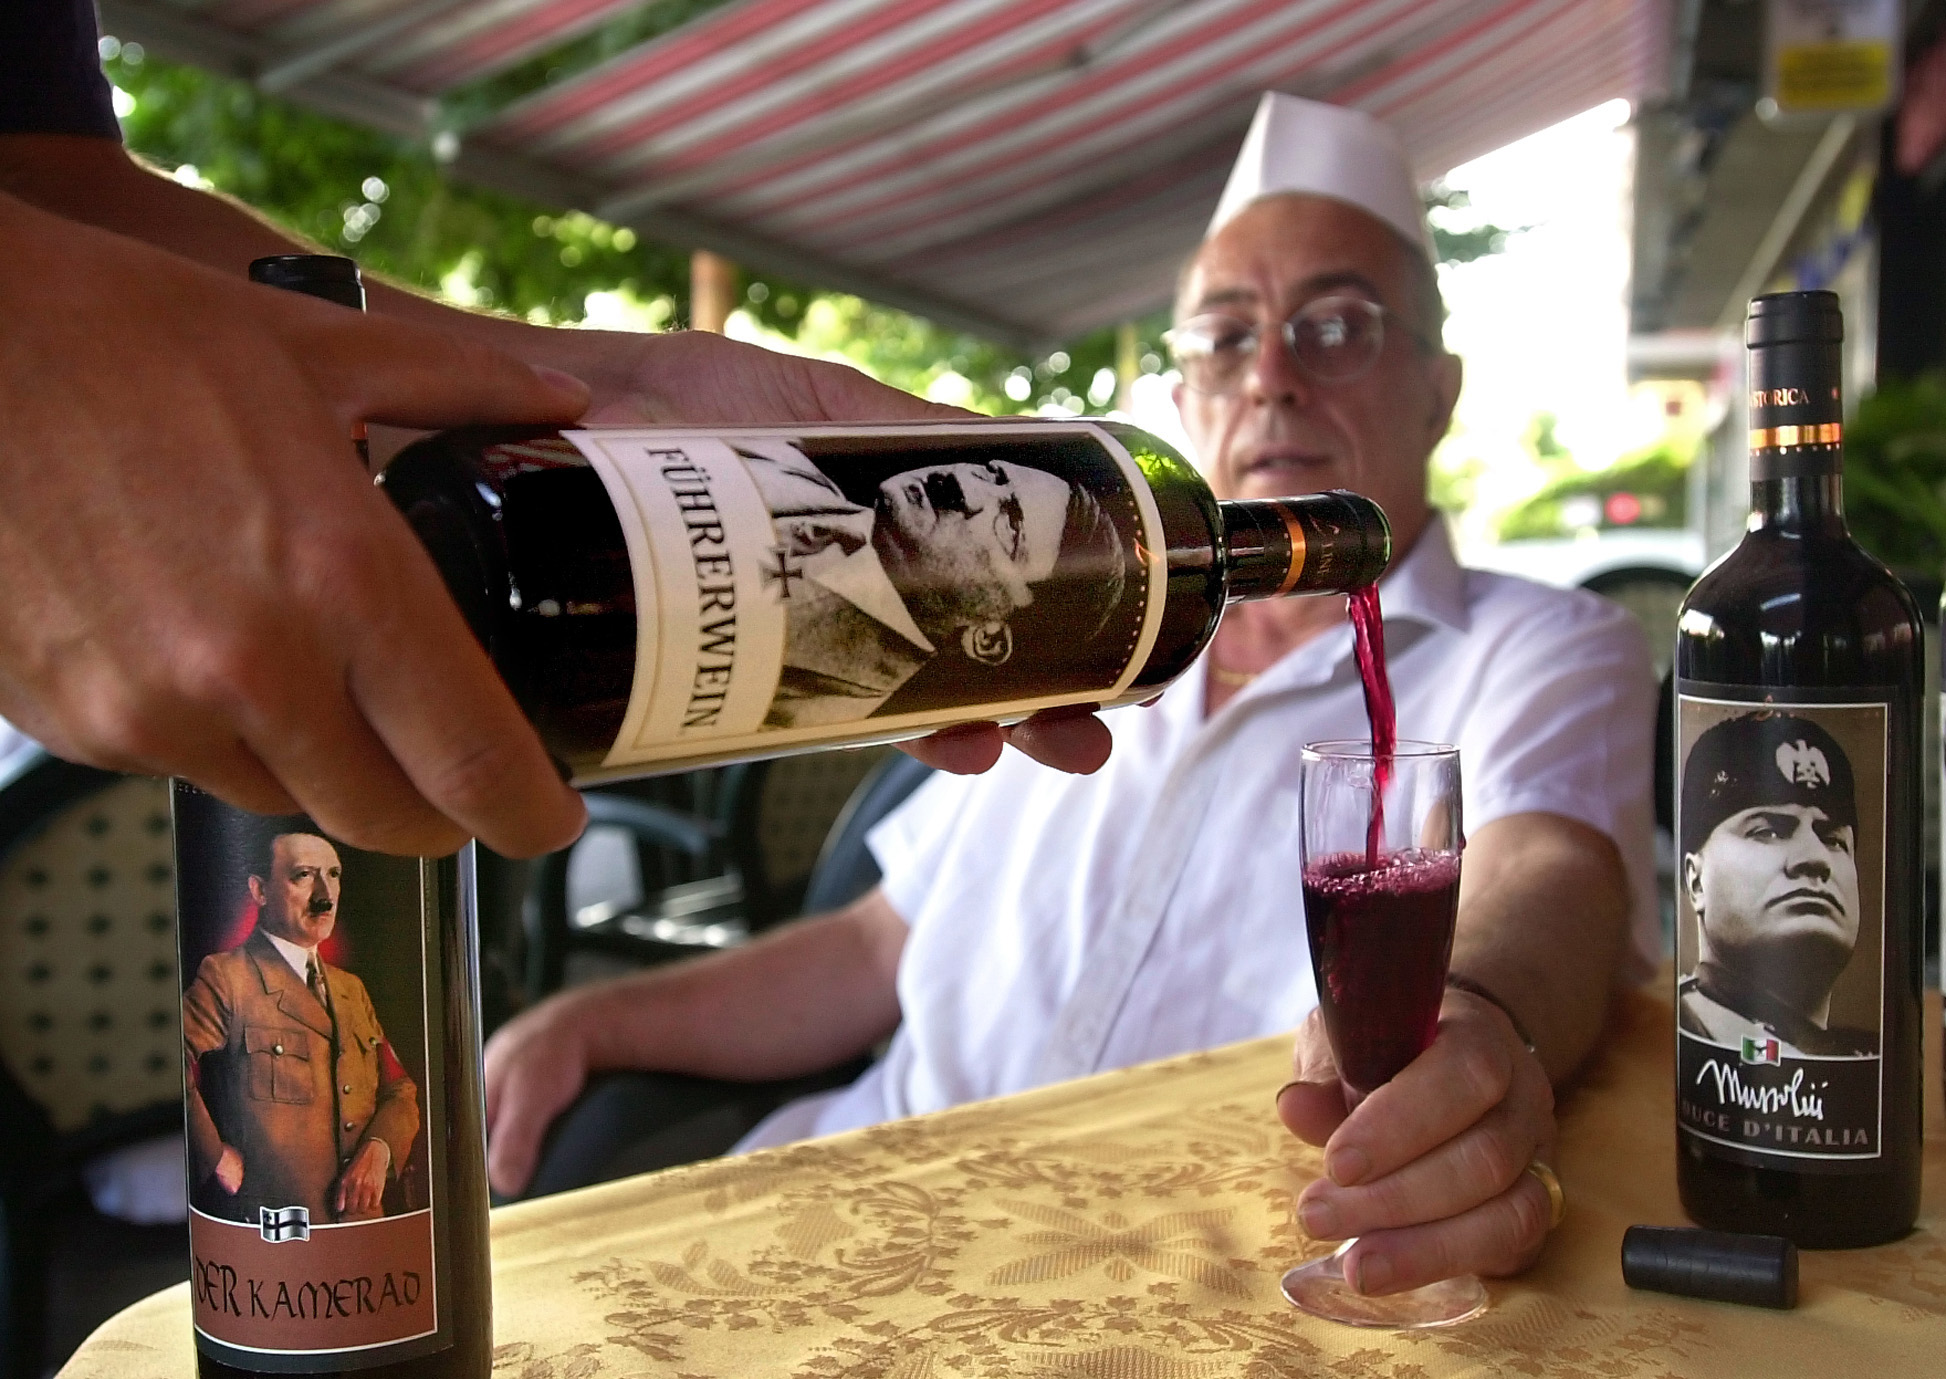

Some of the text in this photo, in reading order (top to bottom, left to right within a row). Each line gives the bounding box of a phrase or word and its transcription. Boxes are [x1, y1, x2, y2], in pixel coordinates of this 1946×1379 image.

[644, 446, 737, 733] FÜHRERWEIN
[1743, 1120, 1869, 1147] D'ITALIA
[195, 1254, 421, 1321] DER KAMERAD
